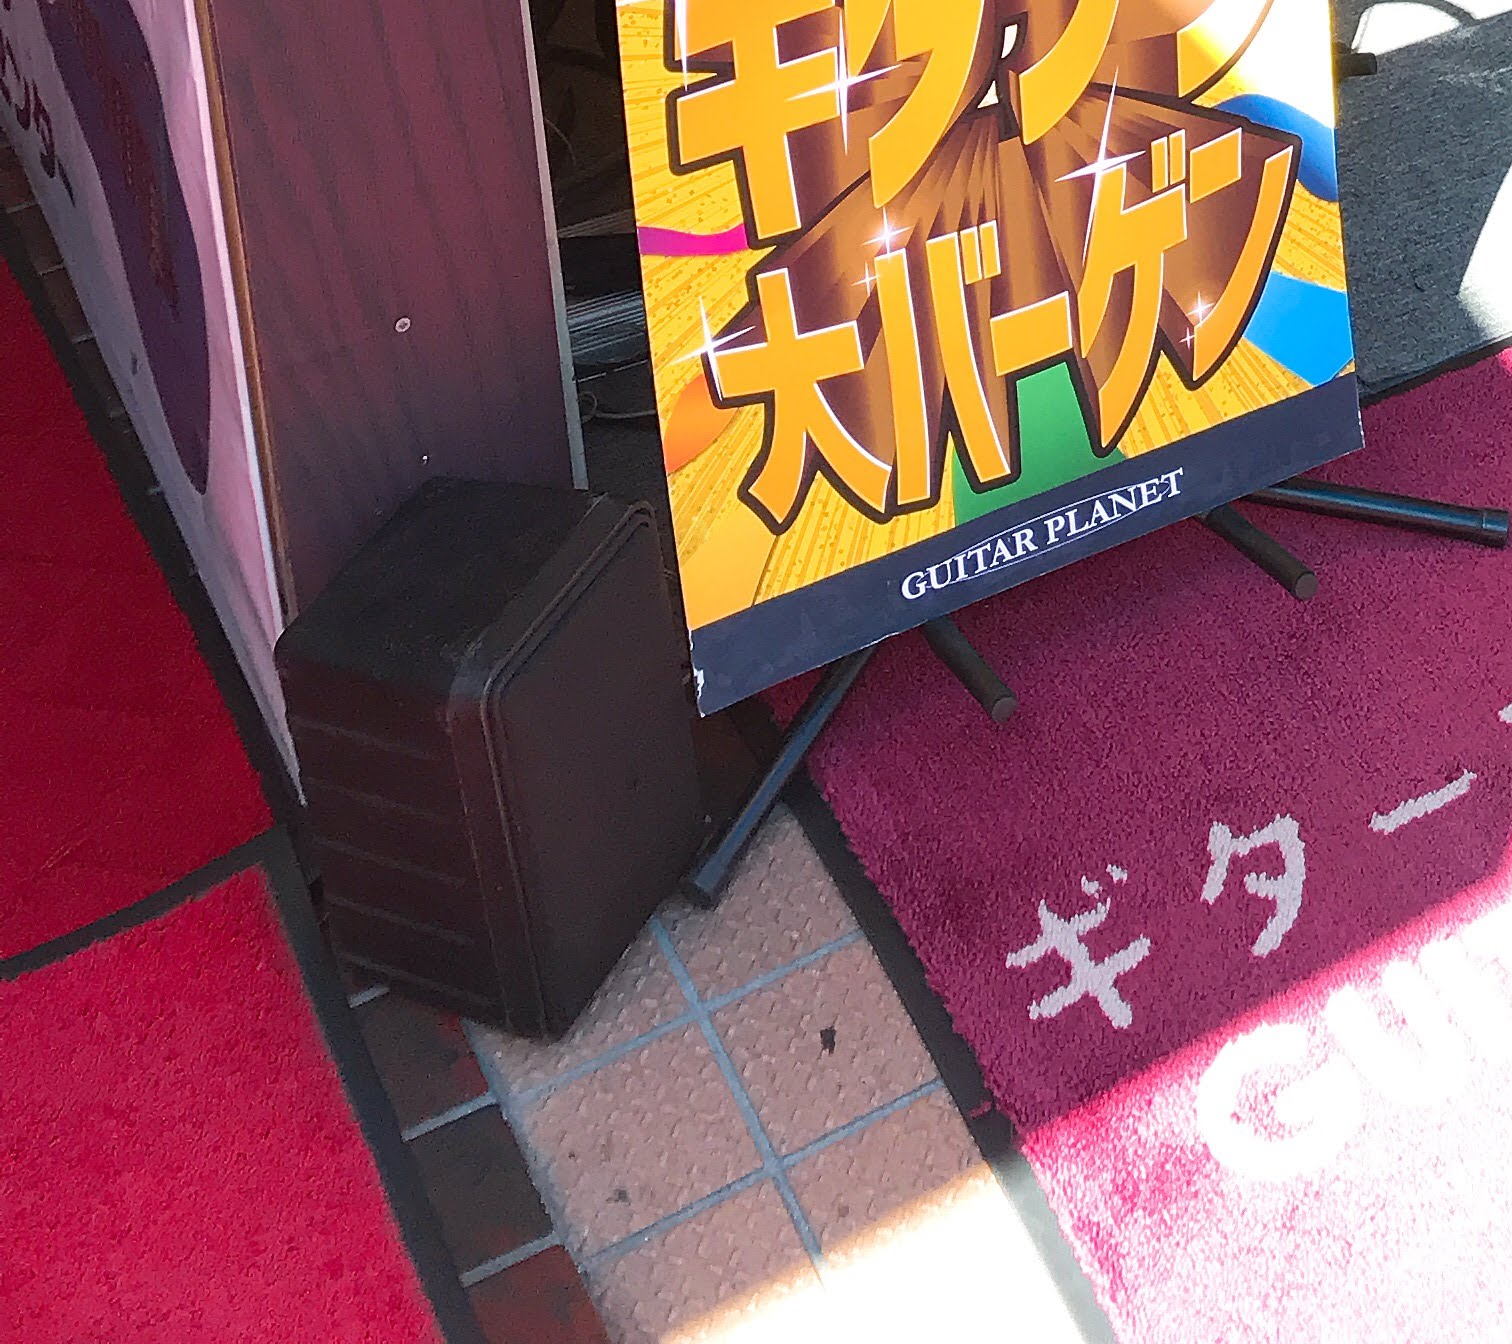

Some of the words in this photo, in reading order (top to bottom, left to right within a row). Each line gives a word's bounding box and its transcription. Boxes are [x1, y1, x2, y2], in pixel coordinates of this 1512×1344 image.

[716, 127, 1297, 524] 大バーゲン
[901, 526, 1038, 600] GUITAR
[1043, 466, 1184, 546] PLANET
